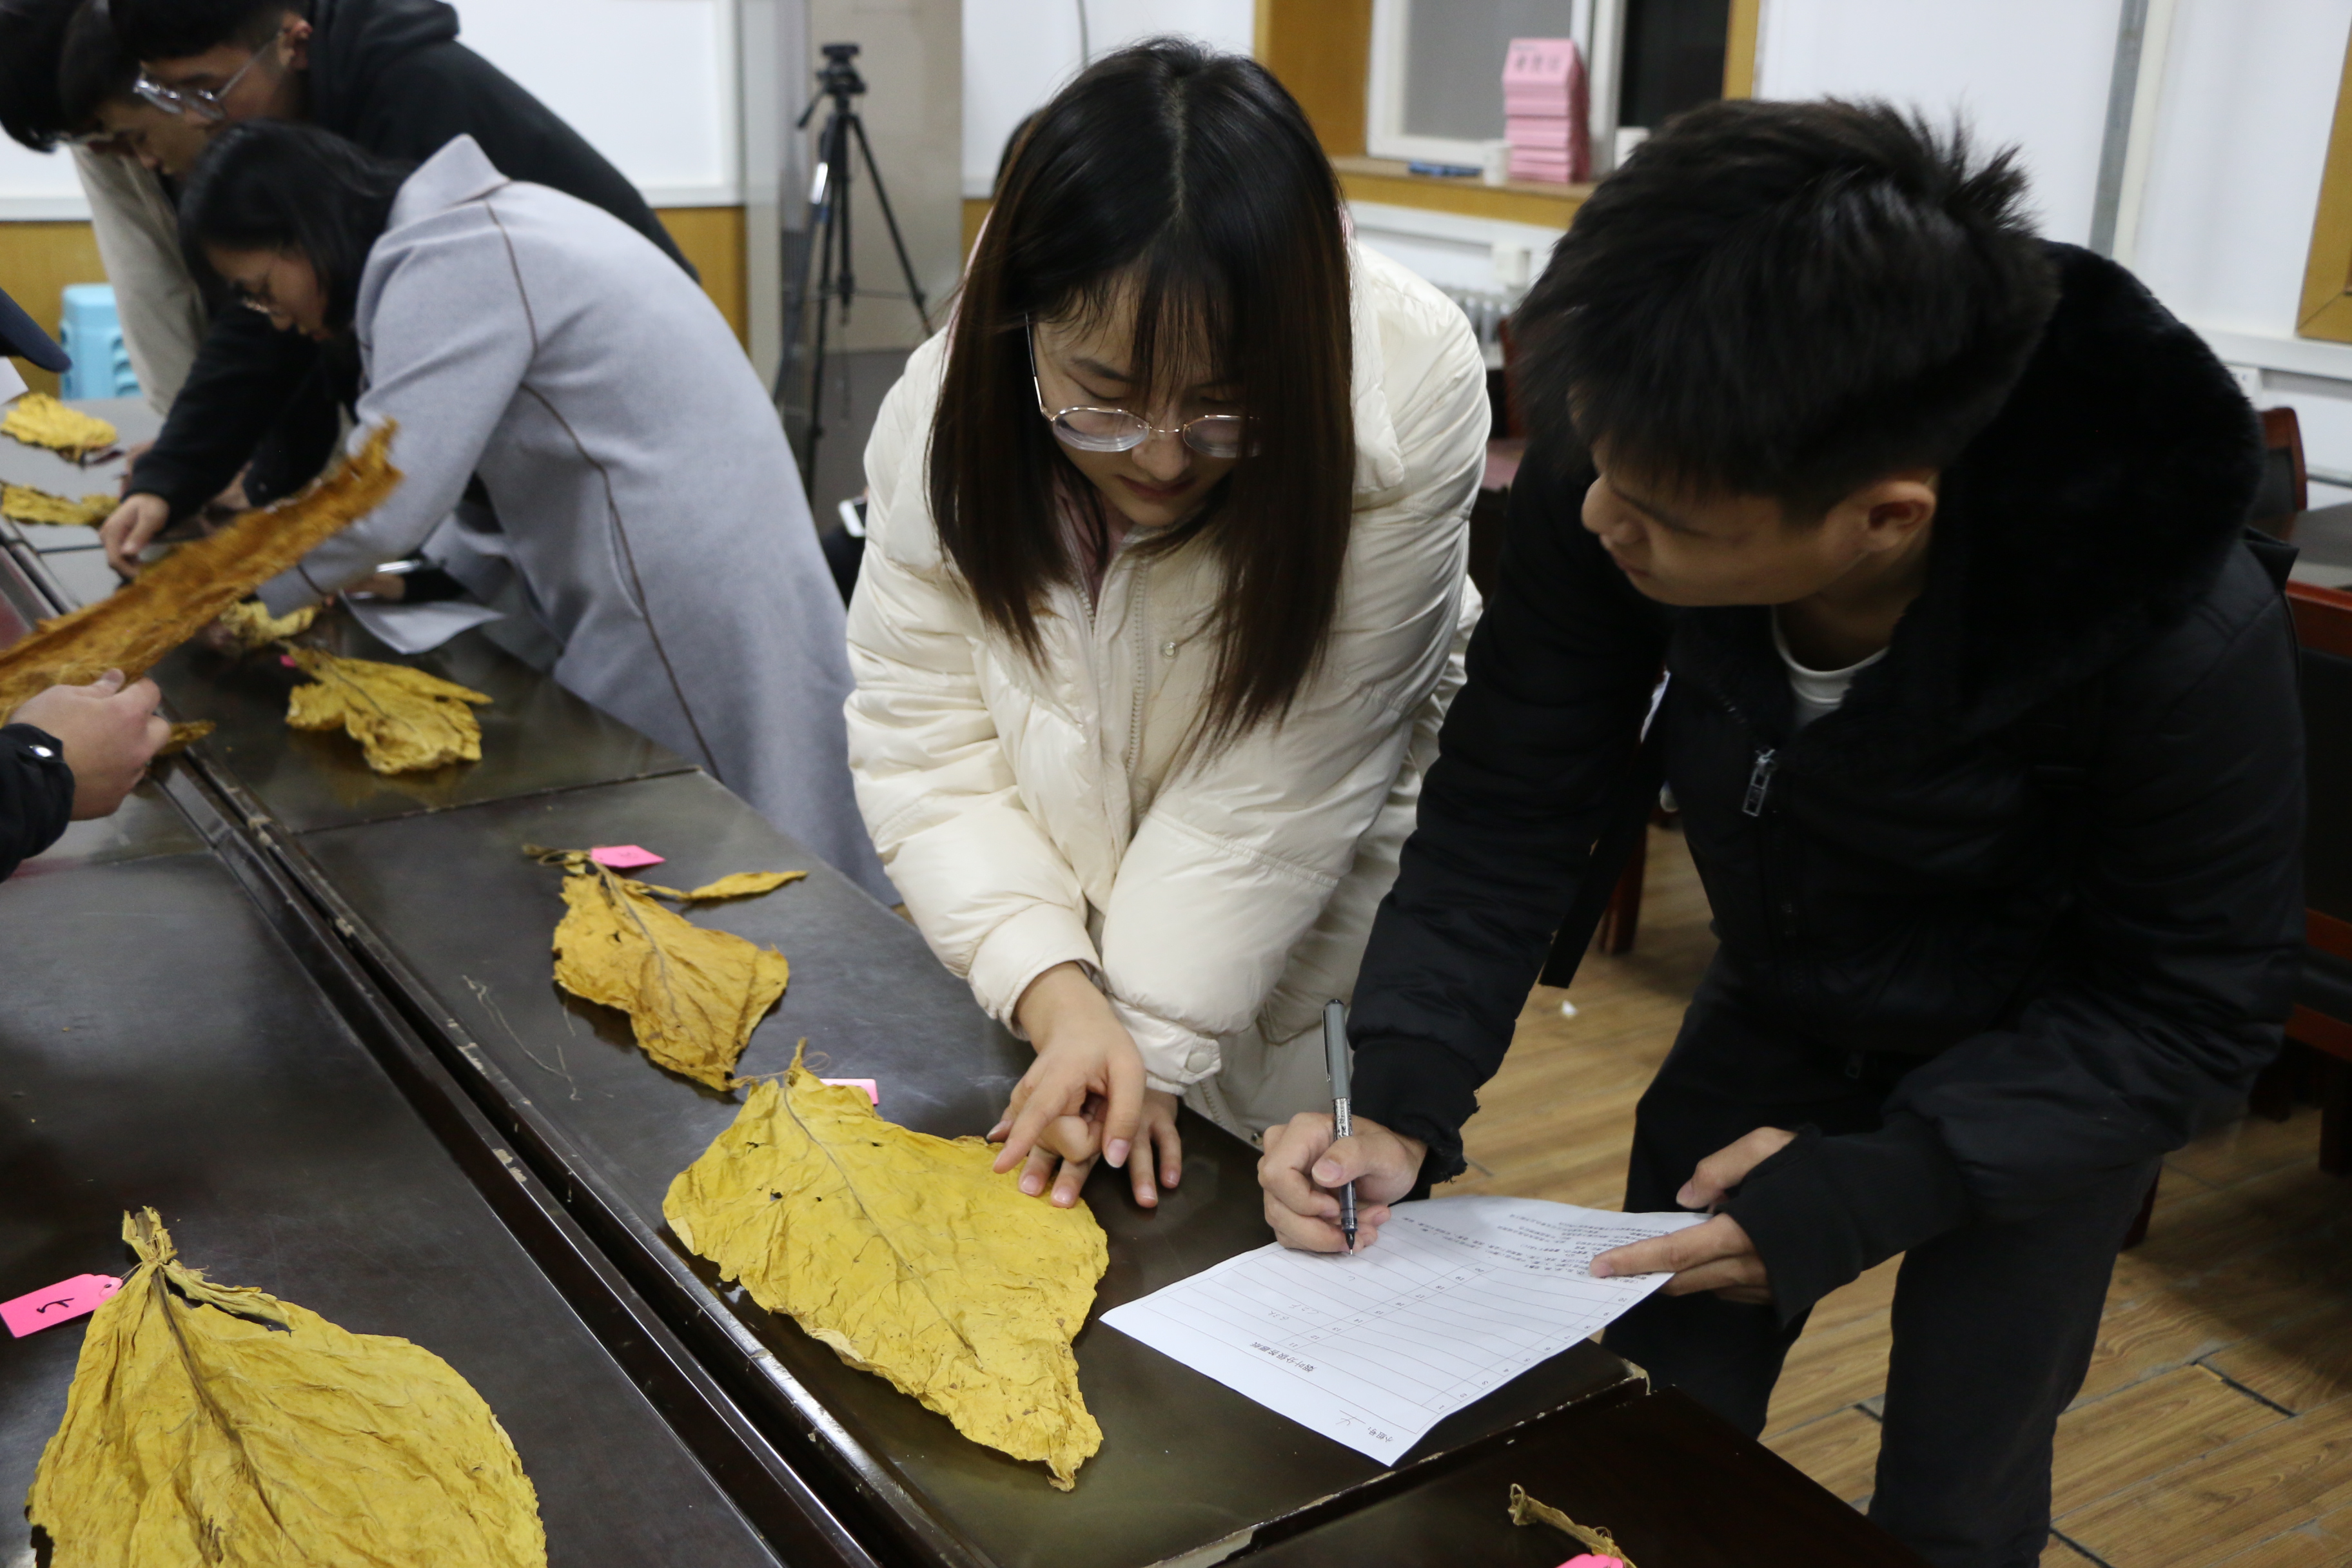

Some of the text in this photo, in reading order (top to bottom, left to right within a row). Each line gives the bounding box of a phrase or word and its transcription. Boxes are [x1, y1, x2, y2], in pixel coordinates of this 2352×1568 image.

[1250, 1342, 1317, 1373] 烟叶分级答题纸
